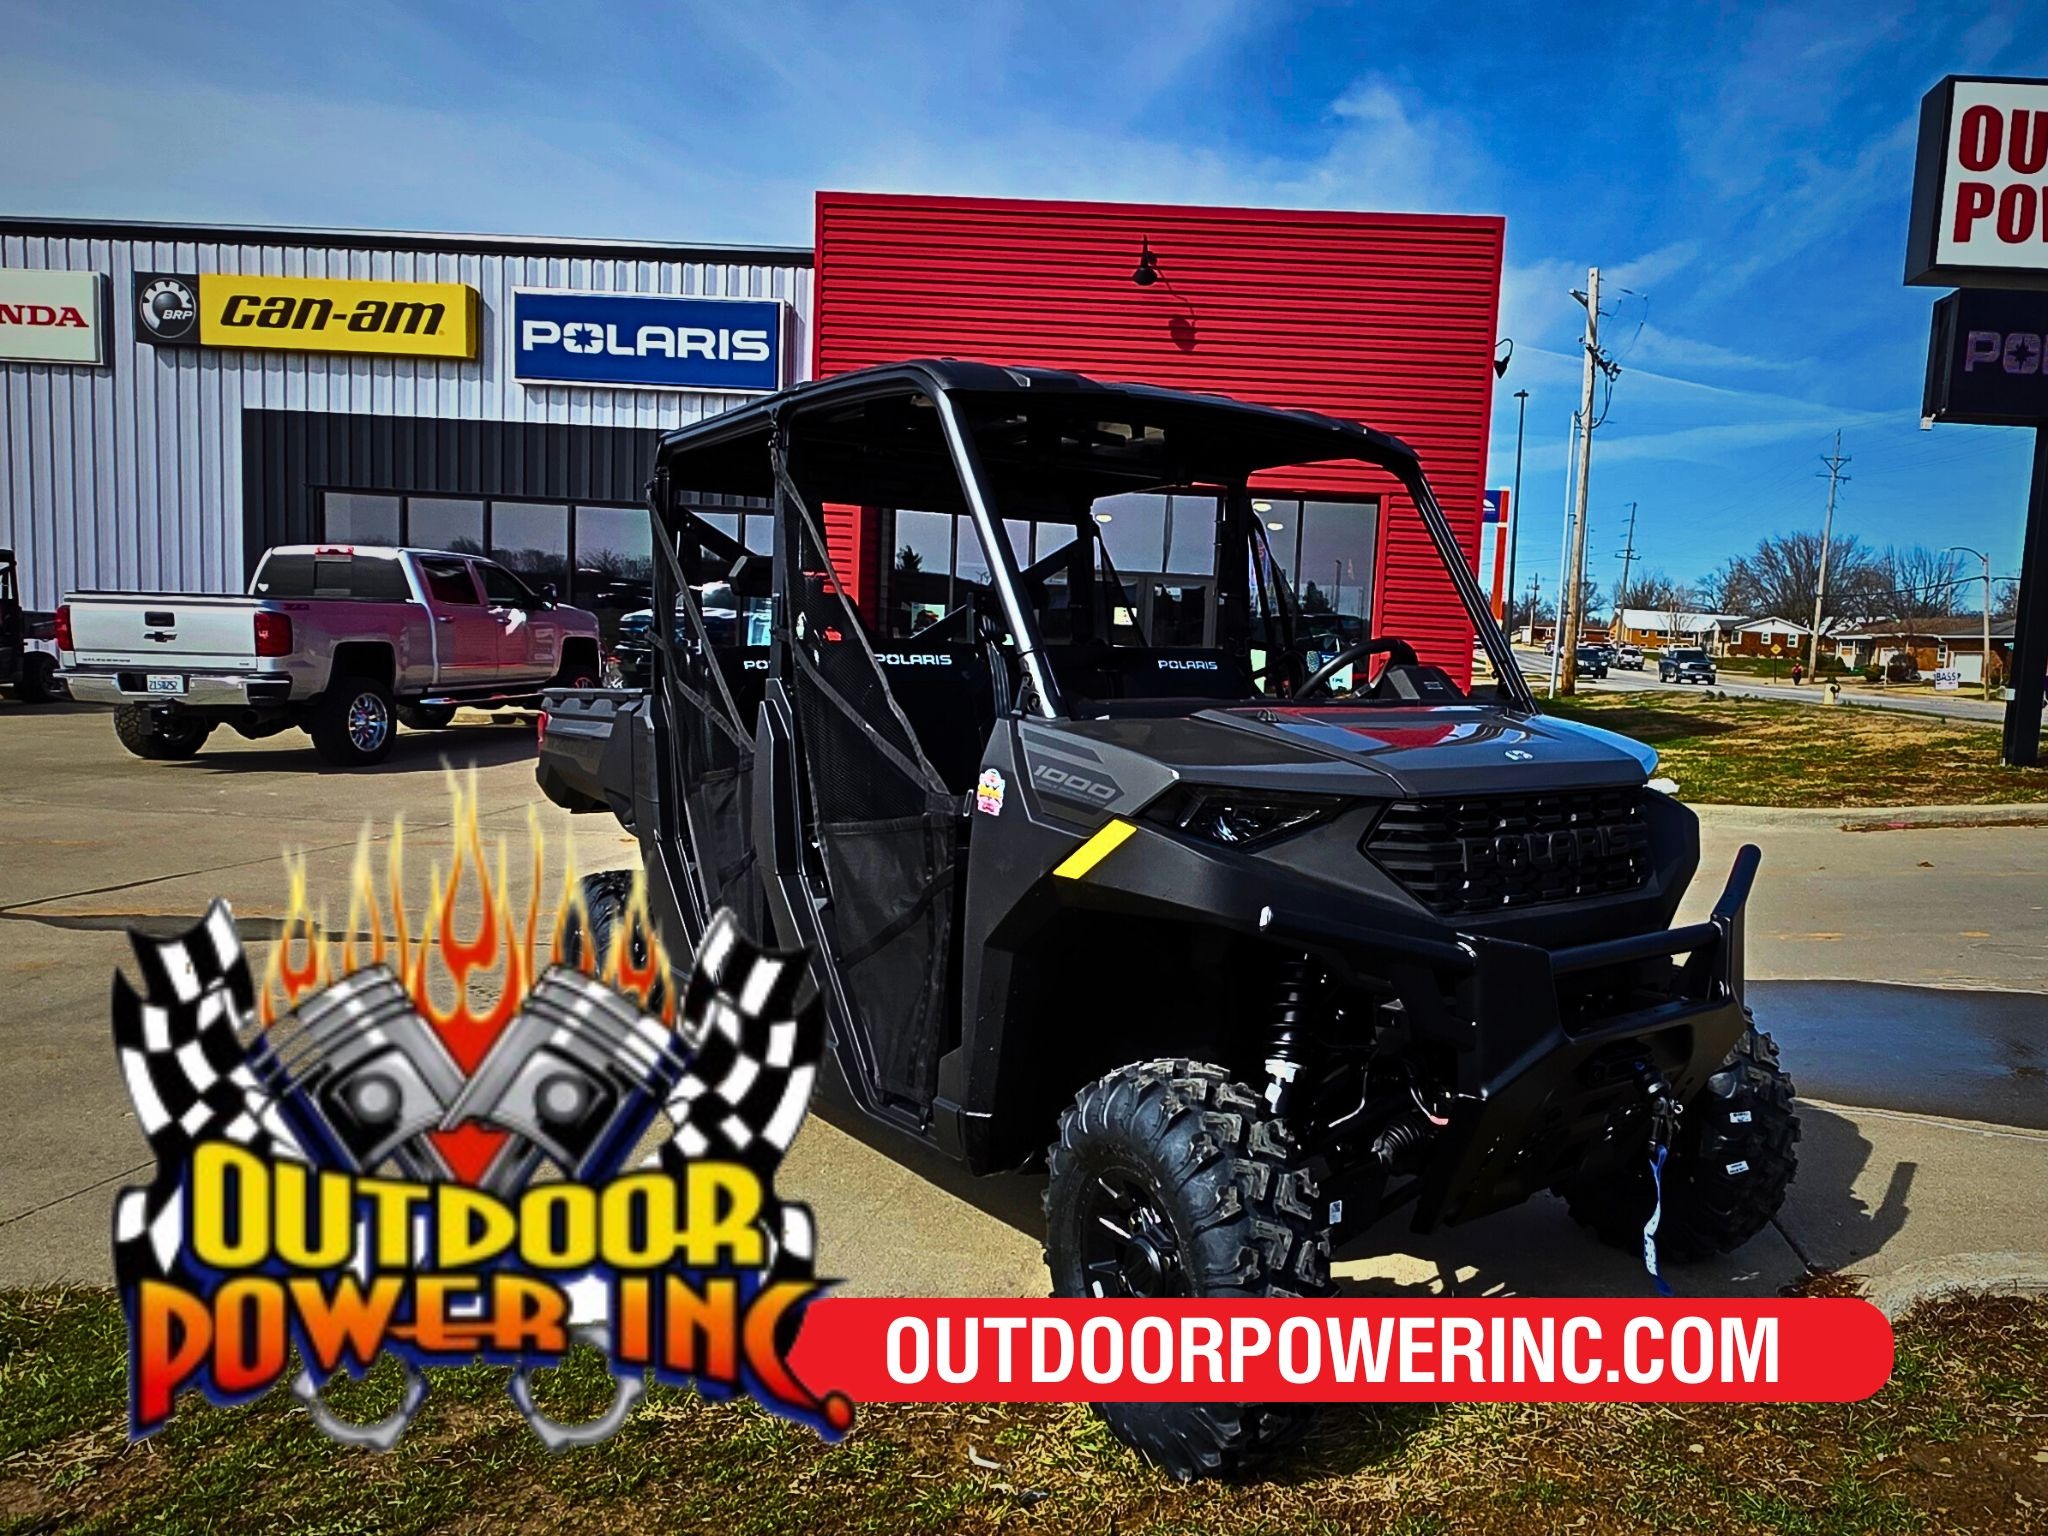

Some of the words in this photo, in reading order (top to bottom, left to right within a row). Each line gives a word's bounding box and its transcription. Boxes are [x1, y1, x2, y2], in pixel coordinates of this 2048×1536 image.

[1953, 182, 2048, 243] PO
[0, 303, 89, 328] NDA
[162, 309, 193, 319] BRP
[220, 295, 446, 335] can-am
[523, 320, 770, 362] POLARIS
[1964, 331, 2048, 375] PO
[743, 660, 771, 669] PO
[873, 654, 953, 665] POLARIS
[1158, 660, 1218, 670] POLARIS
[1034, 765, 1116, 800] 1000
[1456, 826, 1634, 873] POLARIS
